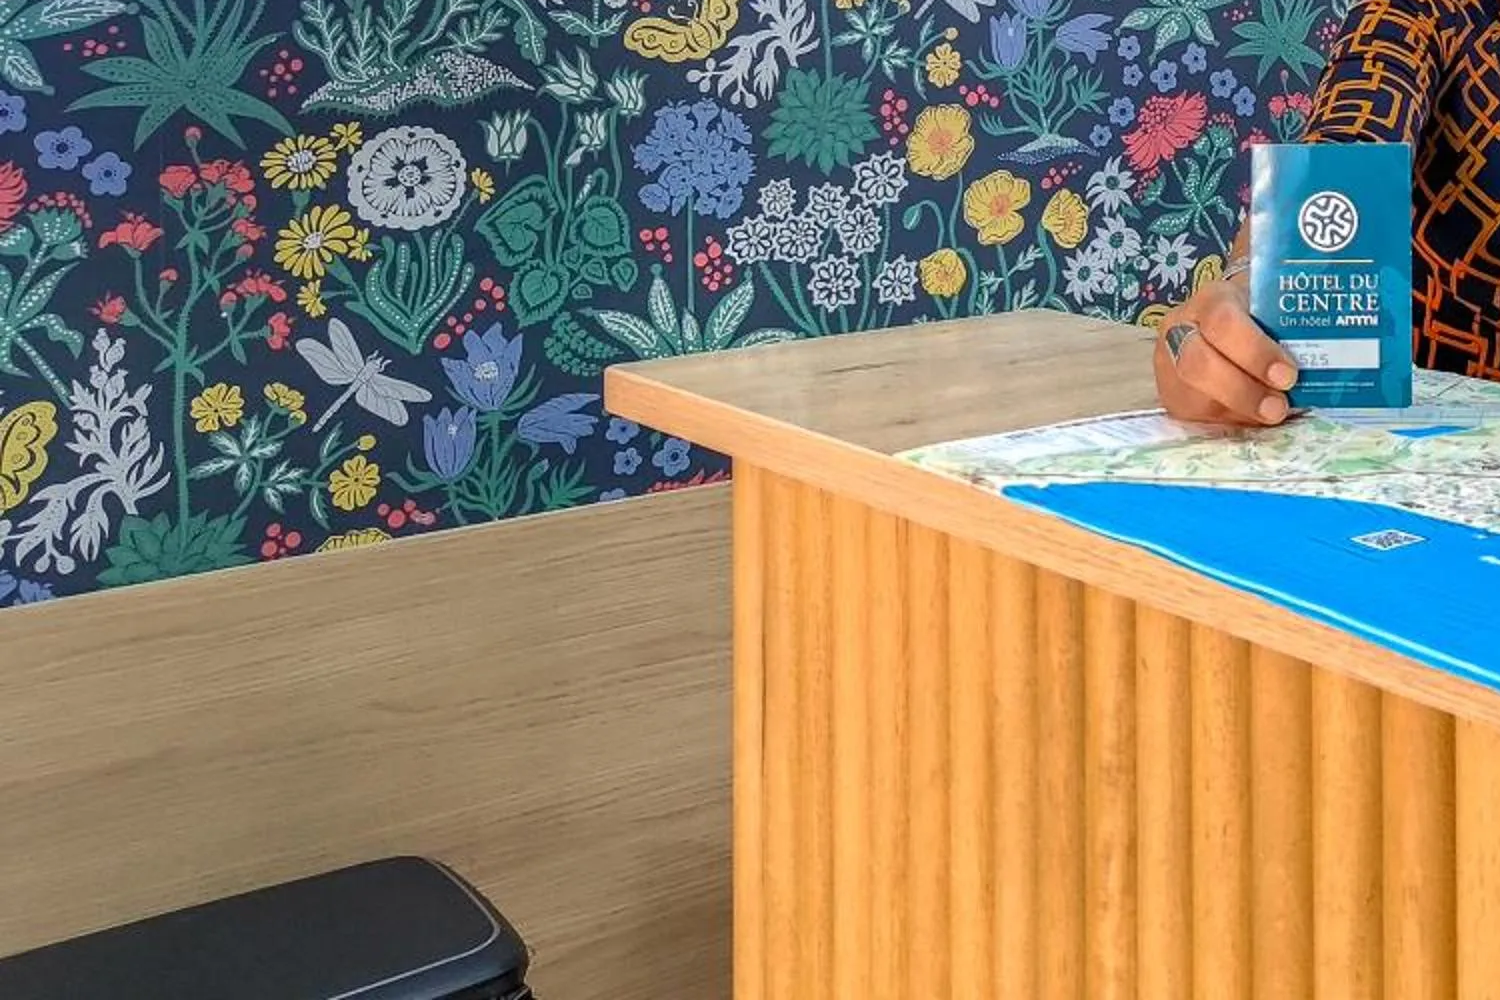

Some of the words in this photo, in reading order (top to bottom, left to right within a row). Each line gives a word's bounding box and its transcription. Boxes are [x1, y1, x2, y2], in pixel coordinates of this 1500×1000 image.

[1279, 271, 1345, 291] HÔTEL
[1350, 273, 1379, 290] DU
[1279, 293, 1380, 312] CENTRE
[1280, 315, 1297, 326] Un
[1301, 315, 1331, 327] hôtel
